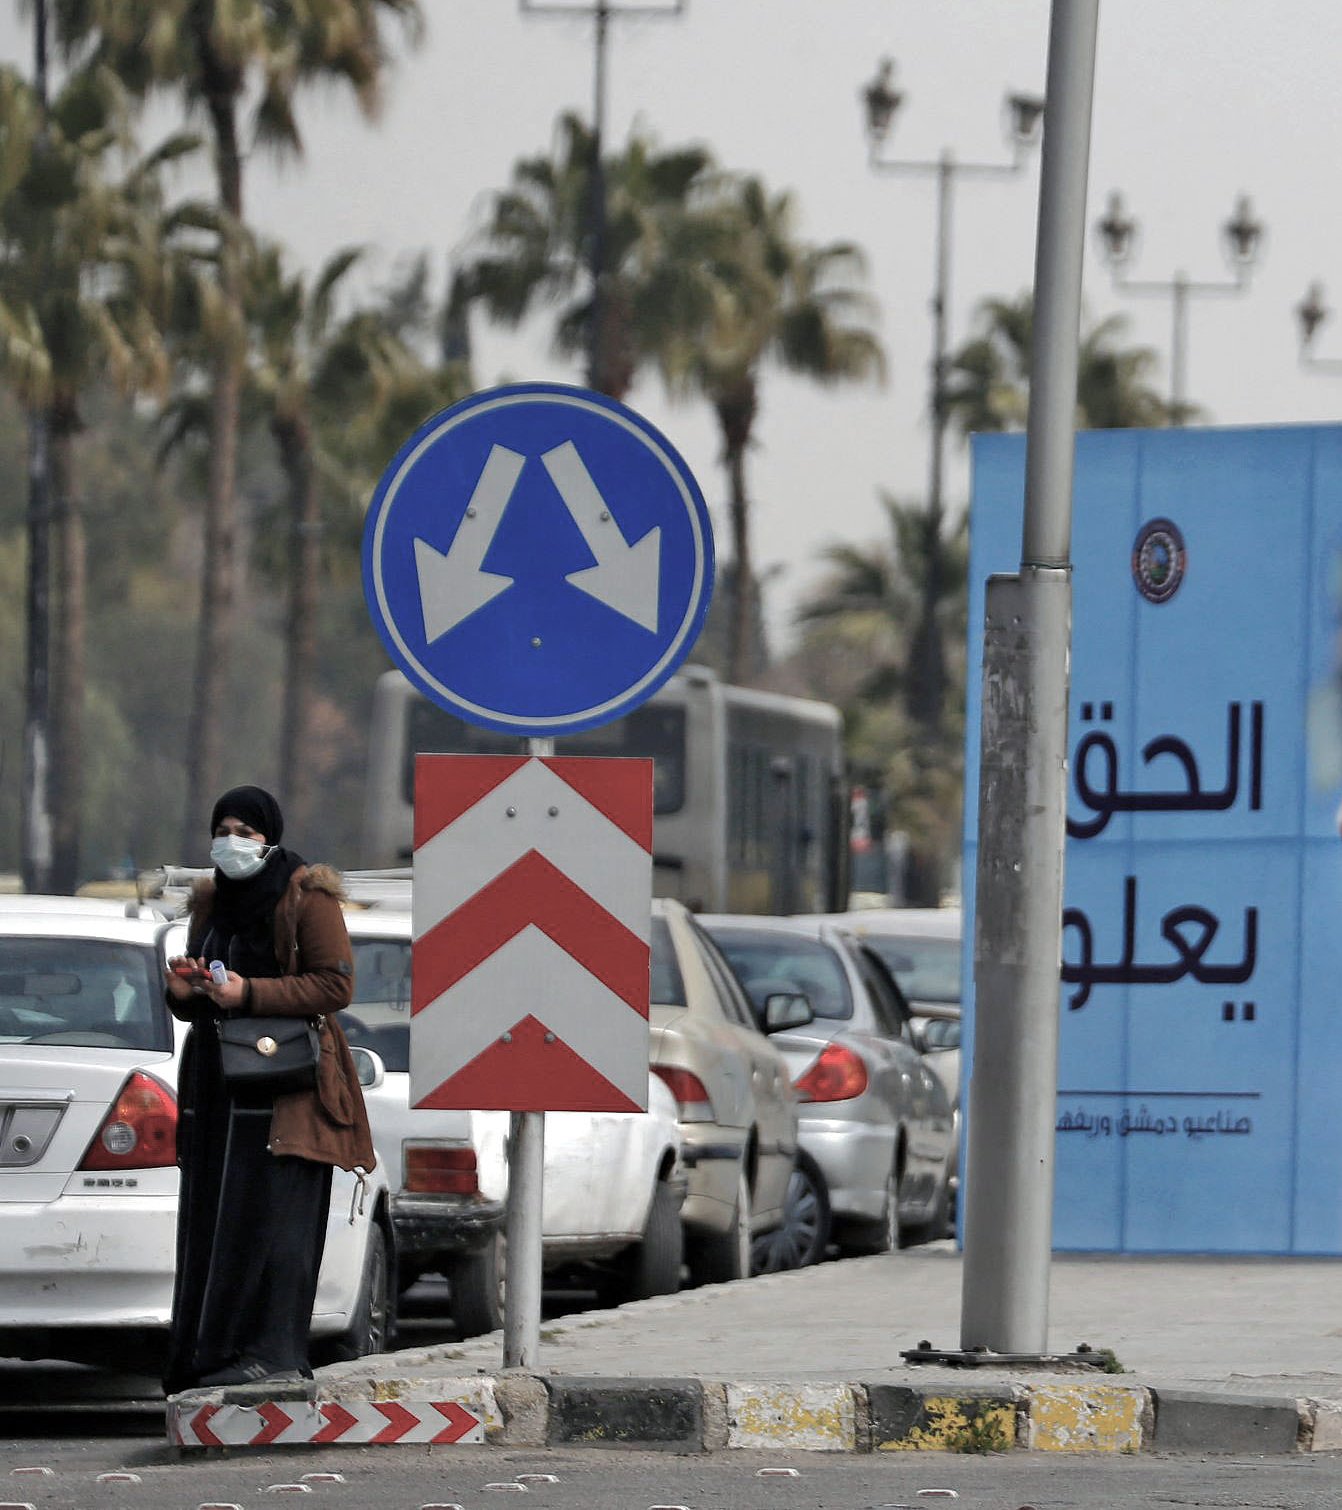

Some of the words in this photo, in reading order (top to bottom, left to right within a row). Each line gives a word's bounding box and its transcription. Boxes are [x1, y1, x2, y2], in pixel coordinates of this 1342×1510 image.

[1066, 701, 1263, 839] الحق
[1060, 875, 1258, 1021] يعلو
[1118, 1104, 1178, 1137] دمشق
